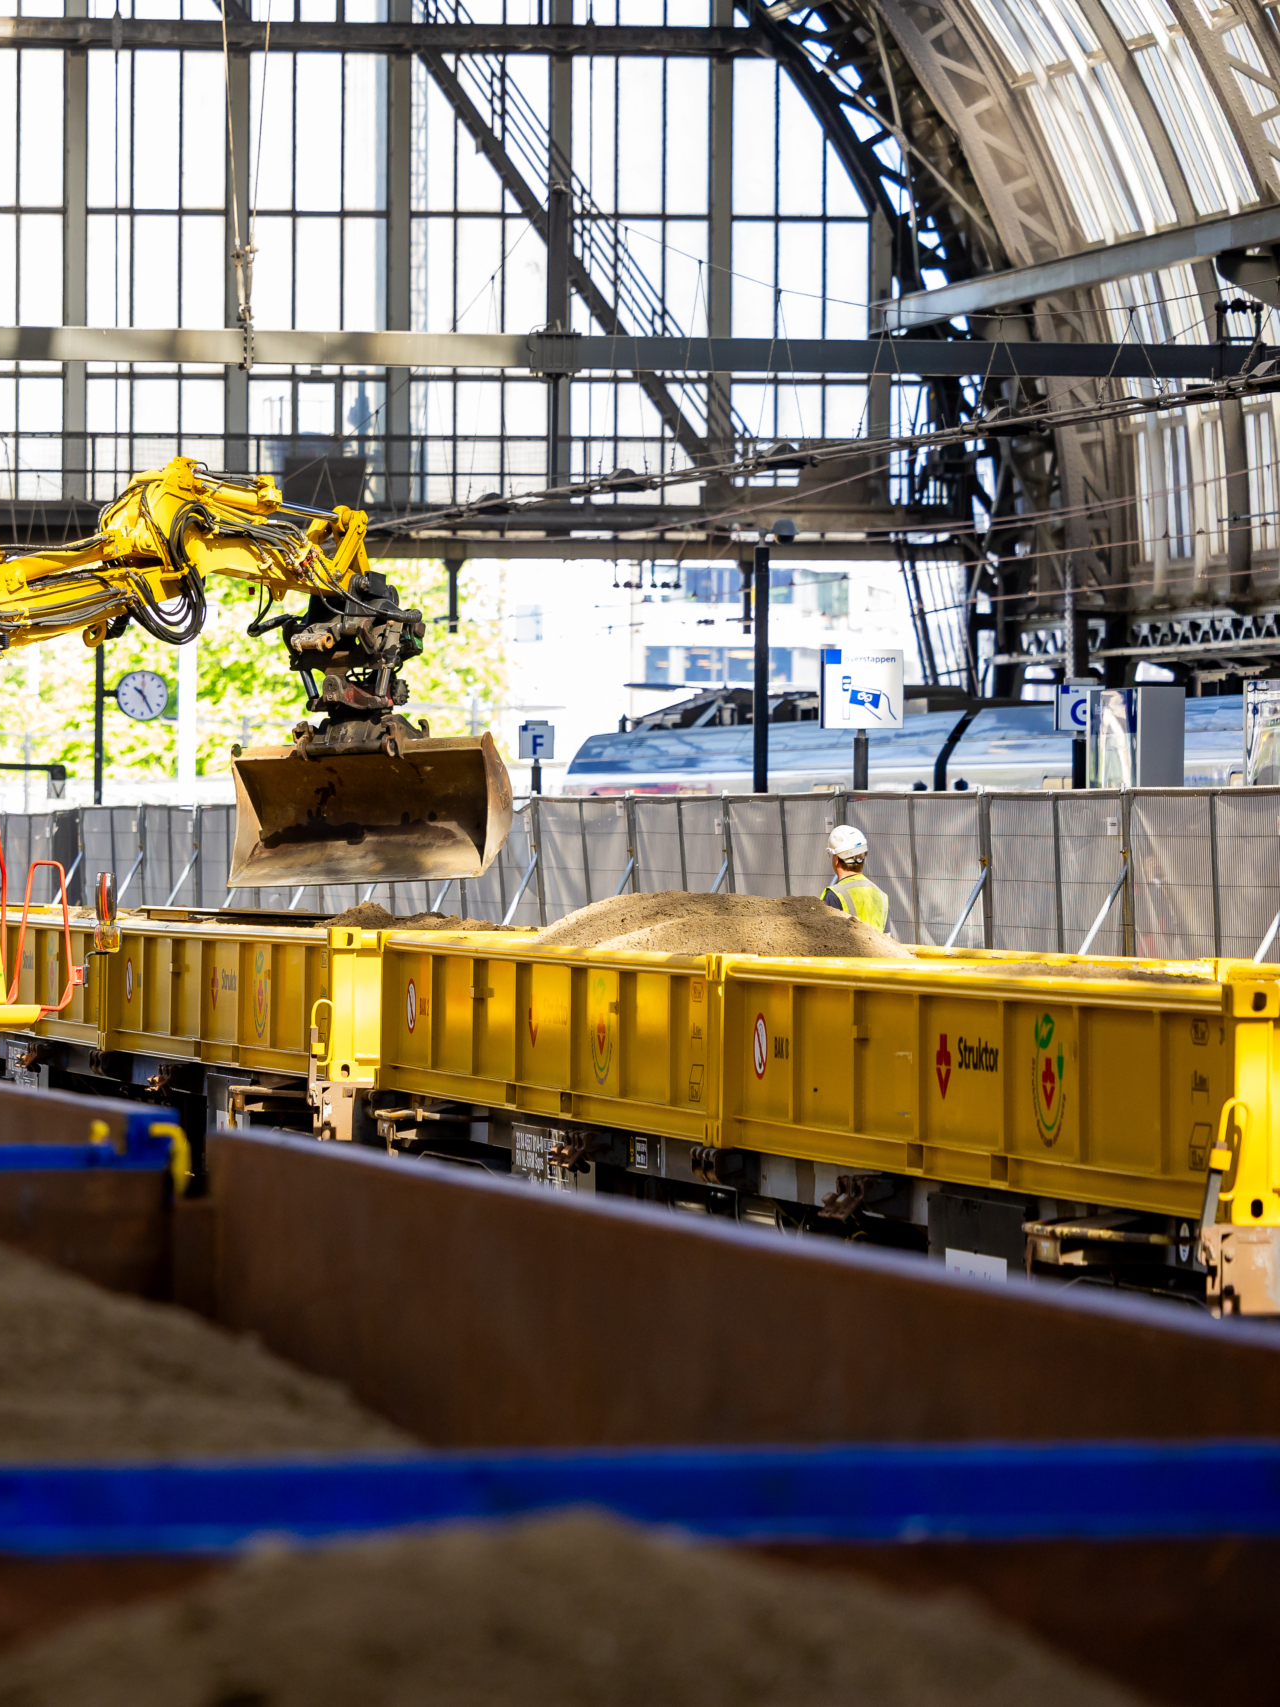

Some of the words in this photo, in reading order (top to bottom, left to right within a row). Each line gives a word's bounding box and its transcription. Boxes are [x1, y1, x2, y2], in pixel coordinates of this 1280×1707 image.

[845, 656, 896, 664] overstappen
[532, 735, 544, 755] F
[774, 1036, 785, 1059] BAK
